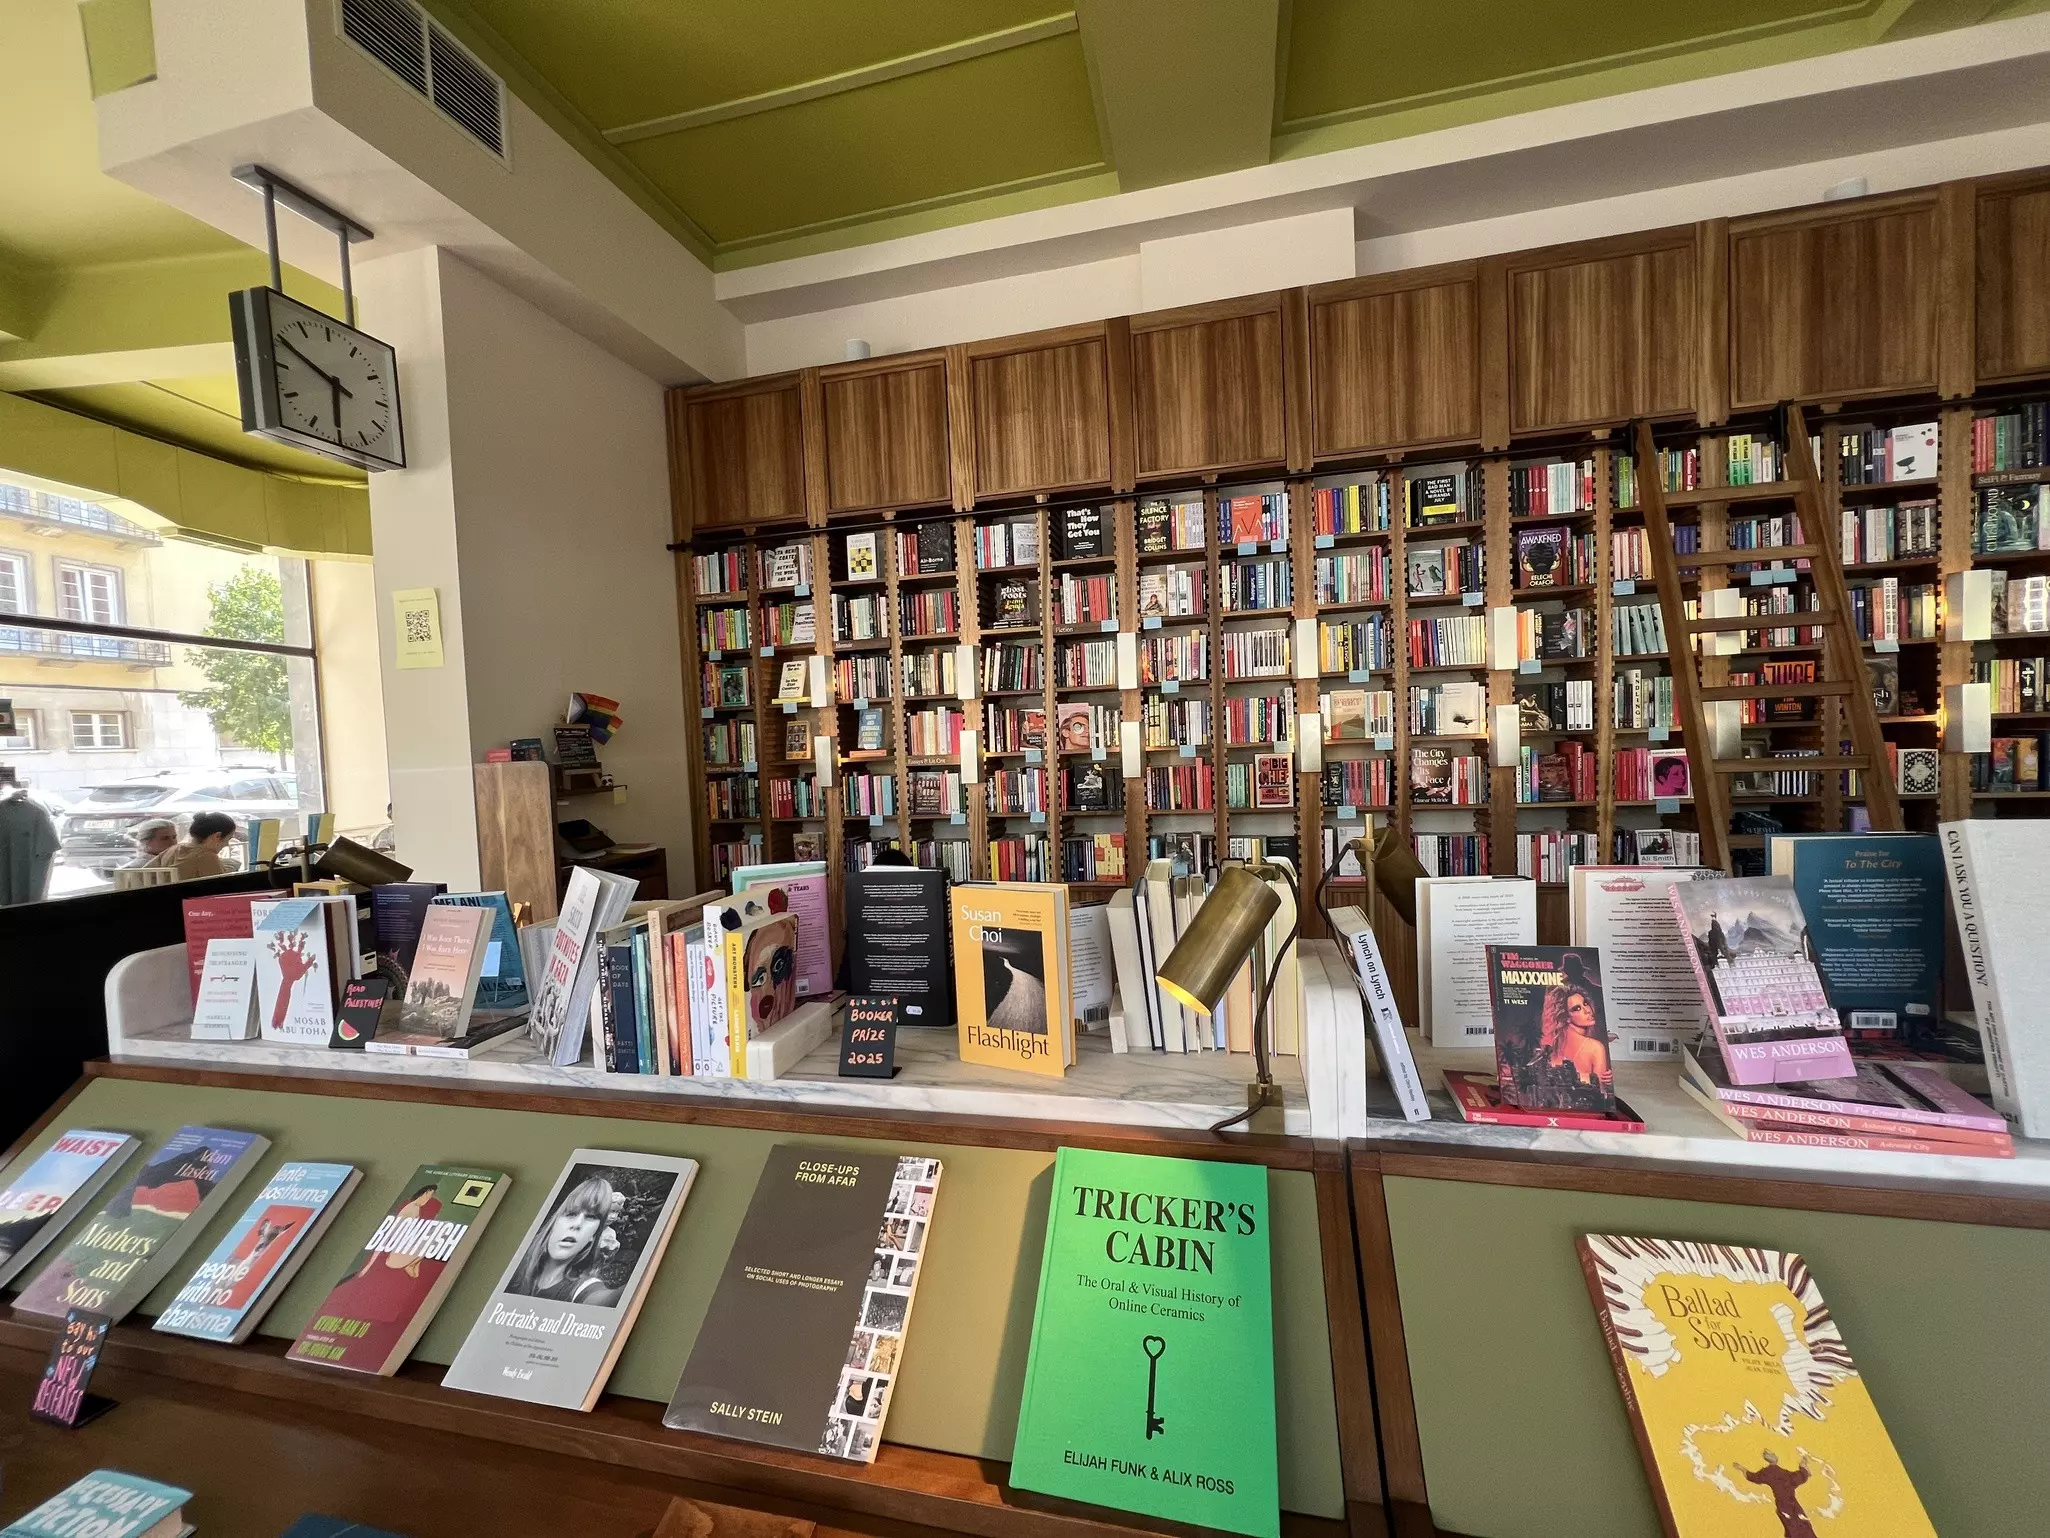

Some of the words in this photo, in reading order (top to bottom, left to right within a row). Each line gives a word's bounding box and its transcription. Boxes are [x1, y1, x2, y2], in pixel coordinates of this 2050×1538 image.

[1067, 508, 1091, 518] That's
[1140, 506, 1167, 516] SILENCE
[1140, 514, 1169, 524] FACTORY
[1067, 522, 1087, 530] They
[1067, 530, 1082, 538] Get
[1144, 544, 1167, 552] COLLINS
[1520, 533, 1562, 545] AWAKENED
[1413, 757, 1448, 768] Changes
[1414, 749, 1429, 758] The
[1430, 748, 1446, 758] City
[1271, 758, 1288, 769] BIG
[1425, 775, 1444, 784] Face
[1948, 830, 1962, 854] CAN
[1845, 860, 1857, 869] To
[1860, 859, 1878, 868] The
[1881, 859, 1902, 869] City
[1955, 861, 1967, 885] ASK
[1959, 887, 1974, 909] YOU
[961, 905, 1002, 923] Susan
[427, 934, 438, 942] Was
[969, 924, 1003, 943] Choi
[1667, 884, 1679, 909] WES
[1677, 912, 1701, 975] ANDERSON
[1357, 933, 1371, 960] Lynch
[1500, 952, 1520, 960] TIM
[1965, 924, 1988, 987] QUESTION?
[1367, 961, 1376, 972] on
[1371, 973, 1385, 1000] Lynch
[1501, 971, 1565, 986] MAXXXINE
[294, 1017, 326, 1025] MOSAB
[850, 1008, 893, 1022] BOOKER
[300, 1027, 327, 1036] TOHA
[851, 1028, 886, 1043] PRIZE
[967, 1025, 1050, 1060] Flashlight
[1733, 1044, 1766, 1061] WES
[1771, 1039, 1847, 1058] ANDERSON
[848, 1052, 883, 1065] 2025
[1719, 1089, 1751, 1102] WES
[1756, 1094, 1844, 1113] ANDERSON
[1547, 1117, 1559, 1127] X
[1726, 1104, 1758, 1117] WES
[1763, 1109, 1851, 1129] ANDERSON
[1899, 1125, 1916, 1135] City
[51, 1137, 121, 1157] WAIST
[1751, 1131, 1781, 1142] WES
[1786, 1134, 1869, 1148] ANDERSON
[199, 1148, 232, 1165] Adam
[174, 1163, 221, 1181] Haslett
[799, 1161, 860, 1176] CLOSE-UPS
[794, 1171, 826, 1185] FROM
[826, 1174, 857, 1187] AFAR
[1073, 1185, 1256, 1236] TRICKER'S
[76, 1223, 157, 1256] Mothers
[365, 1215, 469, 1262] BLOWFISH
[1106, 1230, 1215, 1275] CABIN
[90, 1258, 139, 1283] and
[197, 1261, 250, 1283] people
[744, 1265, 771, 1275] SELECTED
[771, 1269, 789, 1278] SHORT
[801, 1274, 823, 1283] LONGER
[823, 1278, 844, 1287] ESSAYS
[755, 1274, 774, 1283] SOCIAL
[797, 1281, 838, 1292] PHOTOGRAPHY
[1077, 1274, 1098, 1289] The
[1101, 1276, 1126, 1293] Oral
[1128, 1281, 1140, 1295] &
[1142, 1283, 1178, 1300] Visual
[1181, 1286, 1225, 1309] History
[1228, 1293, 1242, 1308] of
[57, 1278, 110, 1309] Sons
[208, 1287, 233, 1306] no
[1660, 1284, 1742, 1320] Ballad
[156, 1304, 233, 1334] charisma
[1109, 1297, 1147, 1315] Online
[1150, 1302, 1206, 1323] Ceramics
[488, 1302, 539, 1330] Portraits
[538, 1311, 565, 1334] and
[560, 1313, 606, 1340] Dreams
[1599, 1309, 1618, 1351] Ballad
[1704, 1317, 1723, 1331] for
[67, 1321, 86, 1342] say
[1688, 1317, 1777, 1364] Sophie
[61, 1341, 73, 1354] to
[76, 1345, 95, 1355] our
[54, 1355, 86, 1391] NEW
[1614, 1362, 1637, 1412] Sophie
[709, 1401, 747, 1420] SALLY
[747, 1406, 783, 1426] STEIN
[1064, 1450, 1108, 1471] ELIJAH
[1111, 1459, 1147, 1479] FUNK
[1150, 1467, 1160, 1481] &
[1163, 1468, 1193, 1487] ALIX
[1196, 1475, 1235, 1496] ROSS
